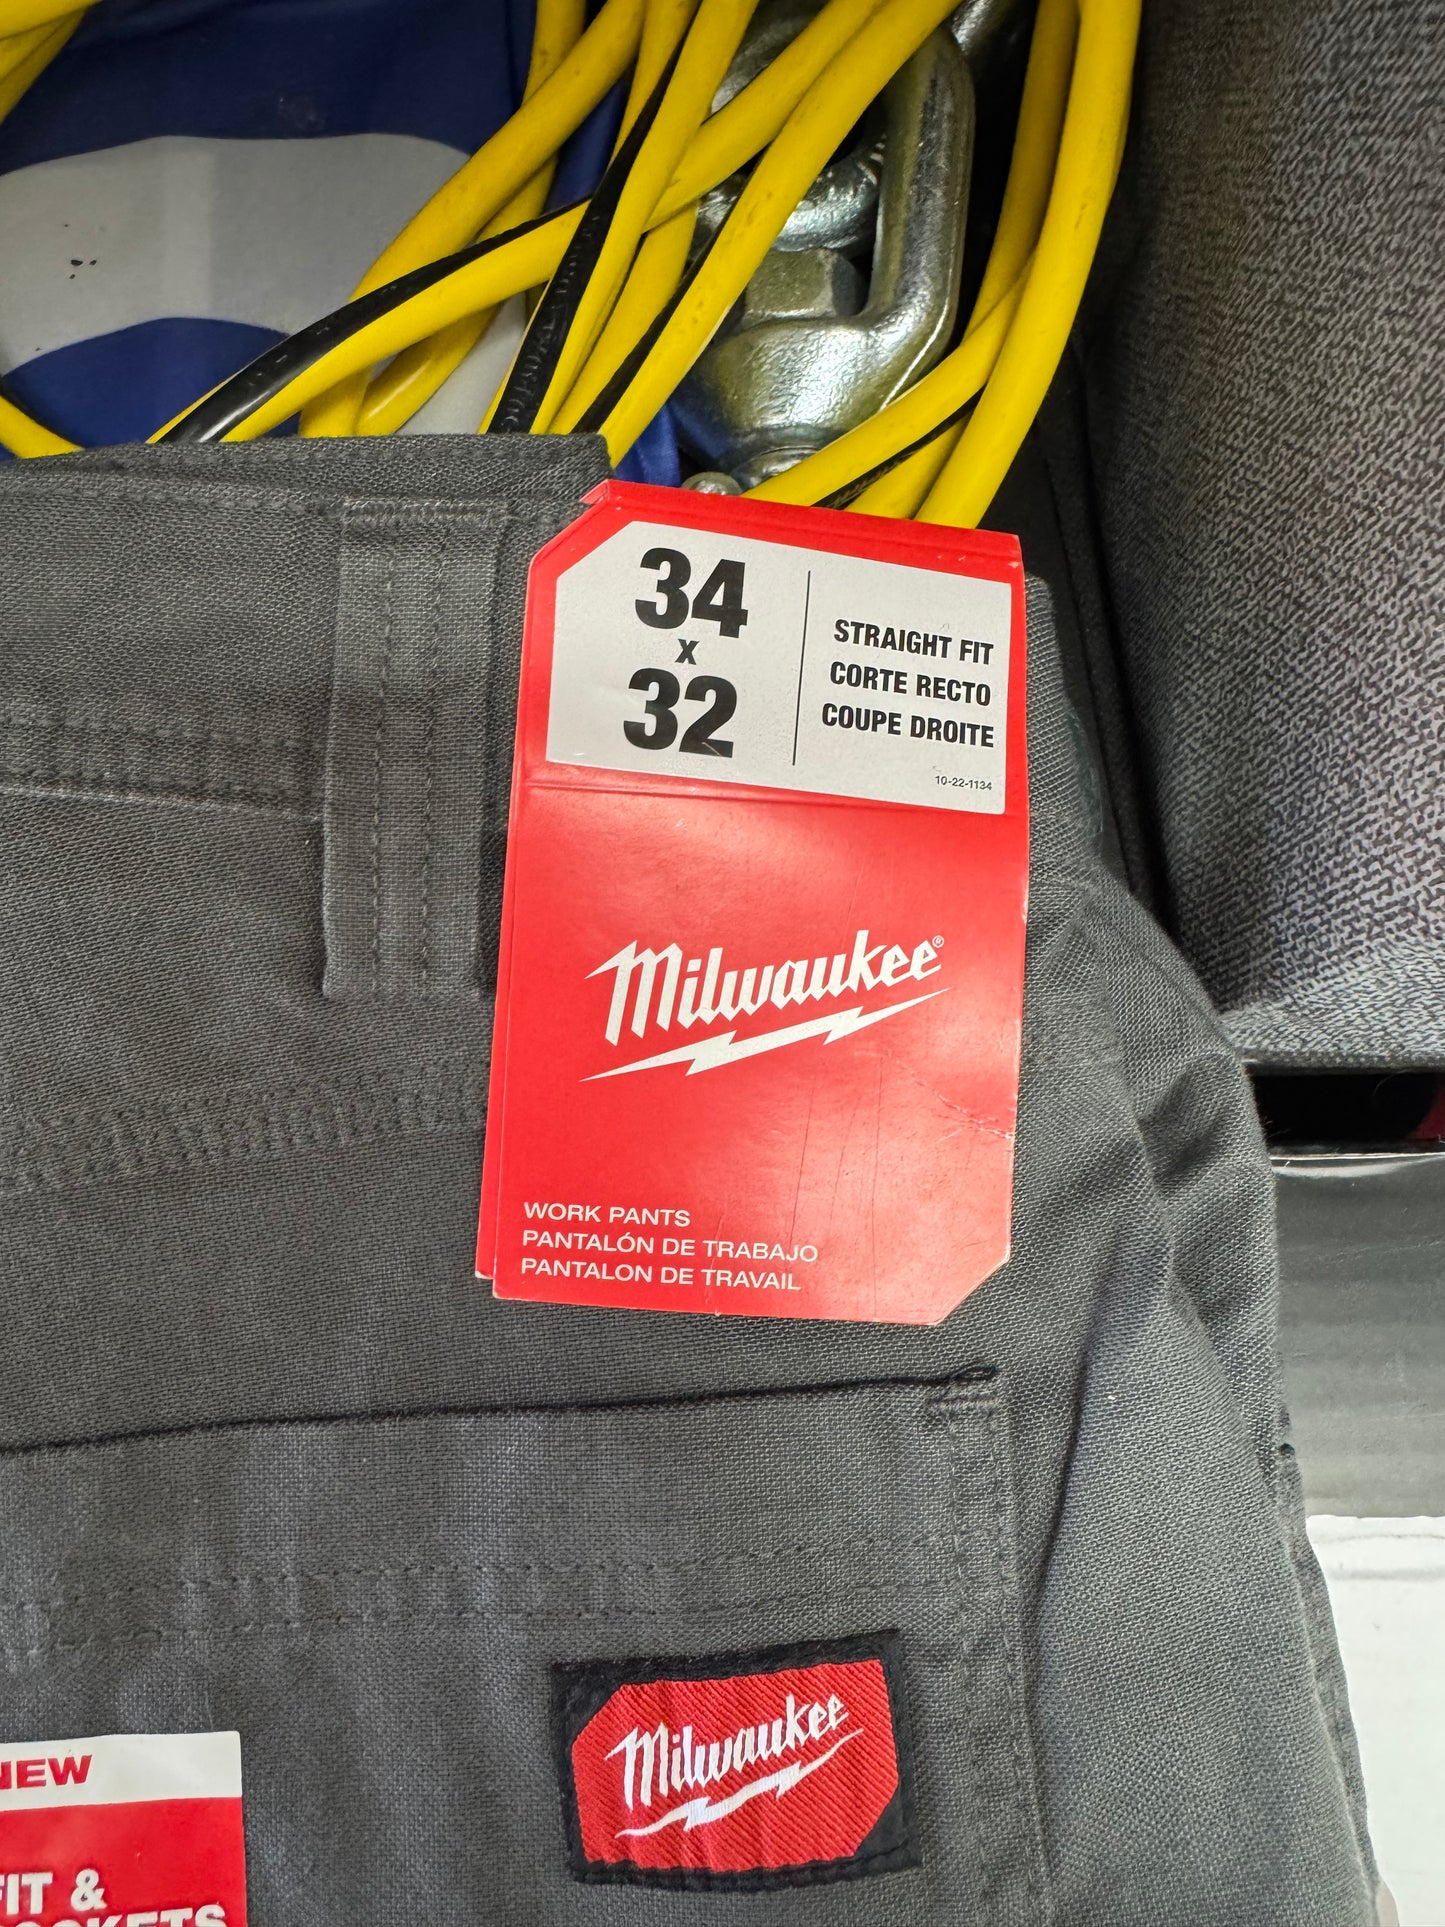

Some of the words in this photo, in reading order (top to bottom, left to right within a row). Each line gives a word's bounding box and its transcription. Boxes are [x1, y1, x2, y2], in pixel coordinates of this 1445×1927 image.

[635, 547, 748, 638] 34
[834, 619, 952, 658] STRAIGHT
[959, 639, 994, 665] FIT
[830, 661, 907, 694] CORTE
[916, 674, 991, 706] RECTO
[623, 668, 737, 758] 32
[822, 703, 901, 735] COUPE
[910, 719, 994, 748] DROITE
[935, 775, 992, 790] 10-22-1134
[523, 1201, 601, 1223] WORK
[609, 1206, 690, 1227] PANTS
[522, 1230, 653, 1254] PANTALÓN
[662, 1238, 695, 1256] DE
[702, 1240, 818, 1263] TRABAJO
[521, 1257, 652, 1282] PANTALON
[660, 1266, 693, 1285] DE
[701, 1268, 801, 1290] TRAVAIL
[0, 1872, 53, 1915] IT
[71, 1868, 107, 1911] &
